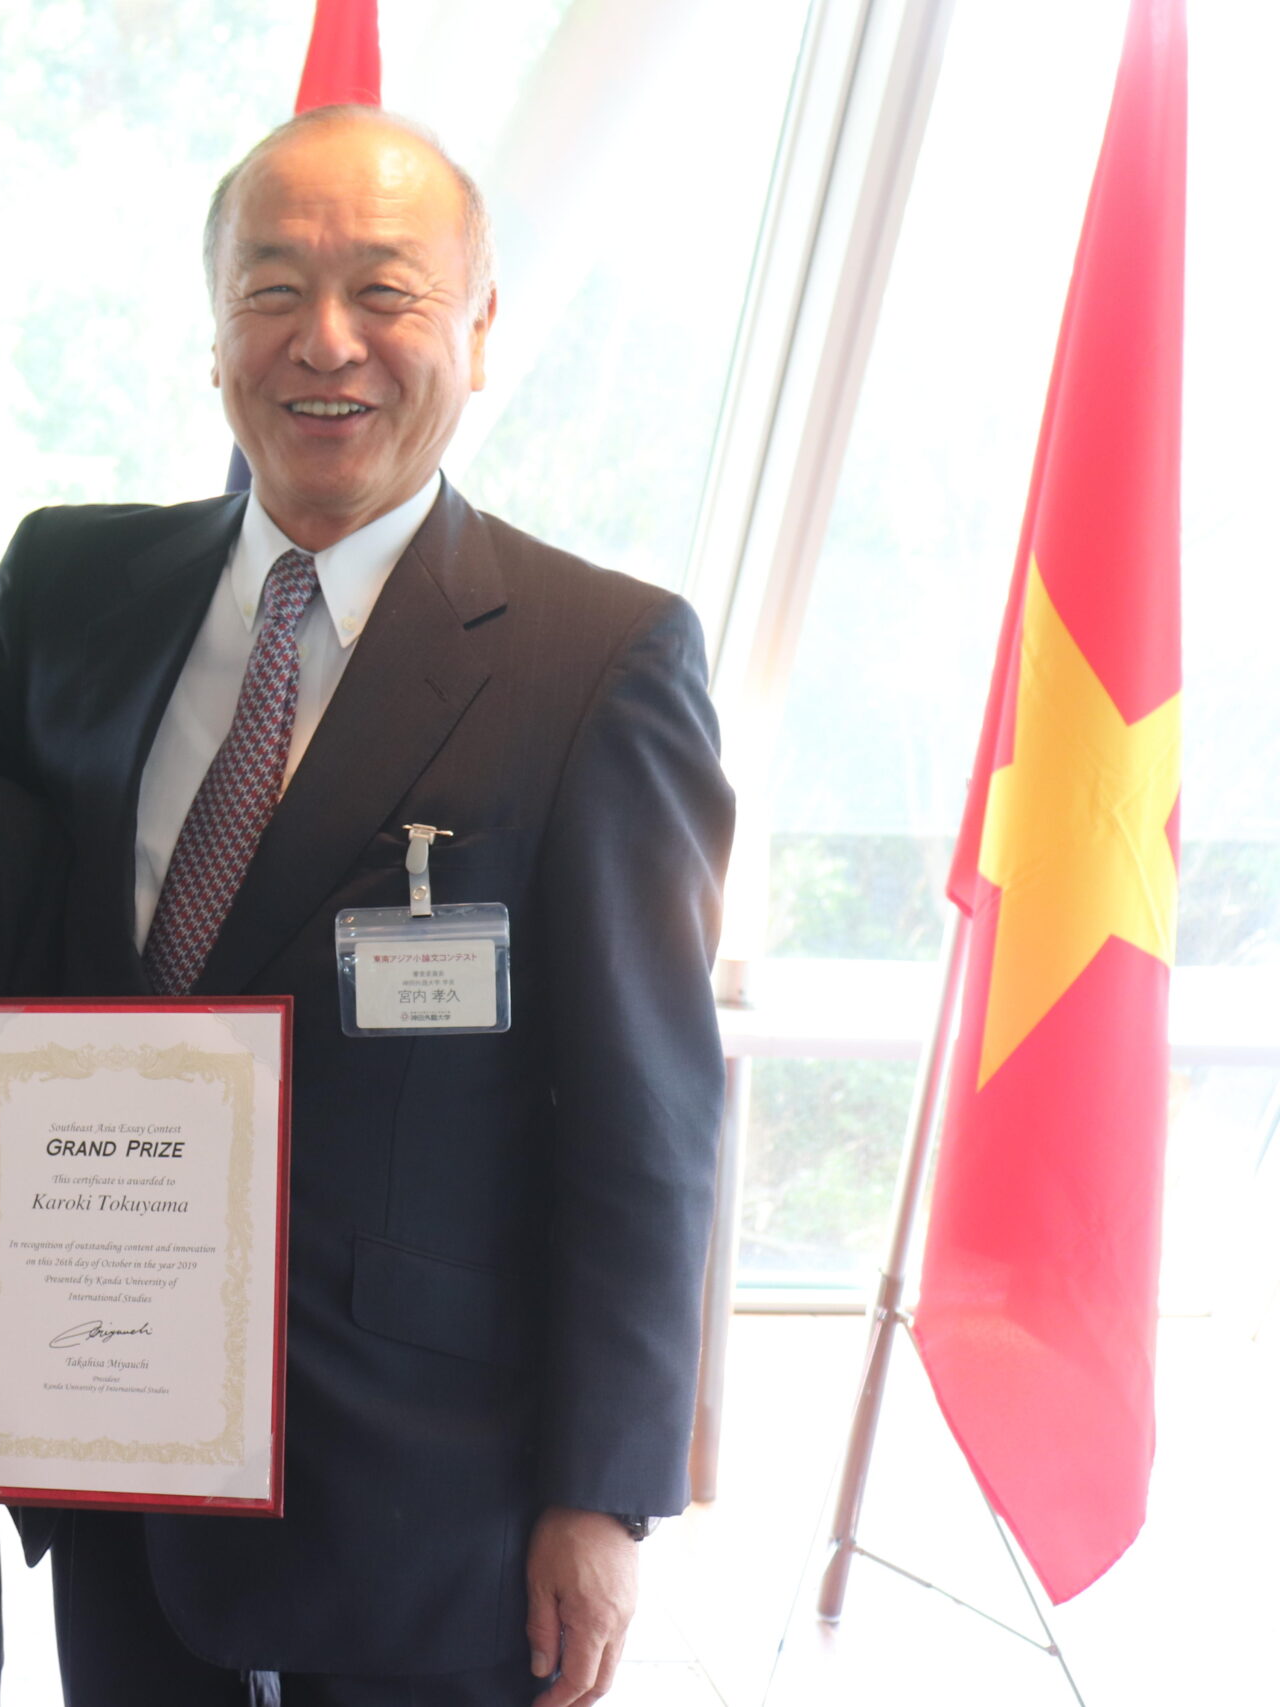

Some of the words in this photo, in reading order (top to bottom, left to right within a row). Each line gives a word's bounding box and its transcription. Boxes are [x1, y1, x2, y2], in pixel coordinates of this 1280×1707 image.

[398, 989, 426, 1003] 宮内
[432, 988, 461, 1003] 孝久
[49, 1121, 93, 1134] Southeast
[95, 1123, 116, 1133] Asia
[120, 1123, 145, 1136] Essay
[147, 1124, 182, 1134] Contest
[46, 1138, 117, 1157] GRAND
[126, 1140, 185, 1158] PRIZE
[52, 1174, 70, 1184] This
[72, 1174, 115, 1187] certificate
[119, 1176, 125, 1185] is
[127, 1176, 164, 1186] awarded
[166, 1176, 176, 1186] to
[31, 1193, 93, 1211] Karoki
[98, 1194, 189, 1216] Tokuyama
[9, 1240, 18, 1248] In
[20, 1240, 63, 1251] recognition
[65, 1241, 74, 1252] of
[75, 1241, 122, 1253] outstanding
[124, 1244, 154, 1252] content
[156, 1243, 171, 1252] and
[173, 1244, 216, 1253] innovation
[26, 1258, 36, 1266] on
[38, 1257, 53, 1266] this
[54, 1258, 73, 1267] 26th
[74, 1259, 89, 1269] day
[91, 1258, 100, 1270] of
[101, 1259, 132, 1268] October
[134, 1261, 142, 1269] in
[144, 1260, 156, 1269] the
[157, 1263, 175, 1271] year
[177, 1261, 197, 1270] 2019
[44, 1275, 83, 1284] Presented
[84, 1275, 94, 1286] by
[96, 1276, 122, 1286] Kanda
[124, 1276, 167, 1288] University
[168, 1278, 178, 1289] of
[68, 1292, 121, 1302] International
[122, 1293, 152, 1303] Studies
[65, 1357, 105, 1368] Takahisa
[106, 1358, 149, 1371] Miyauchi
